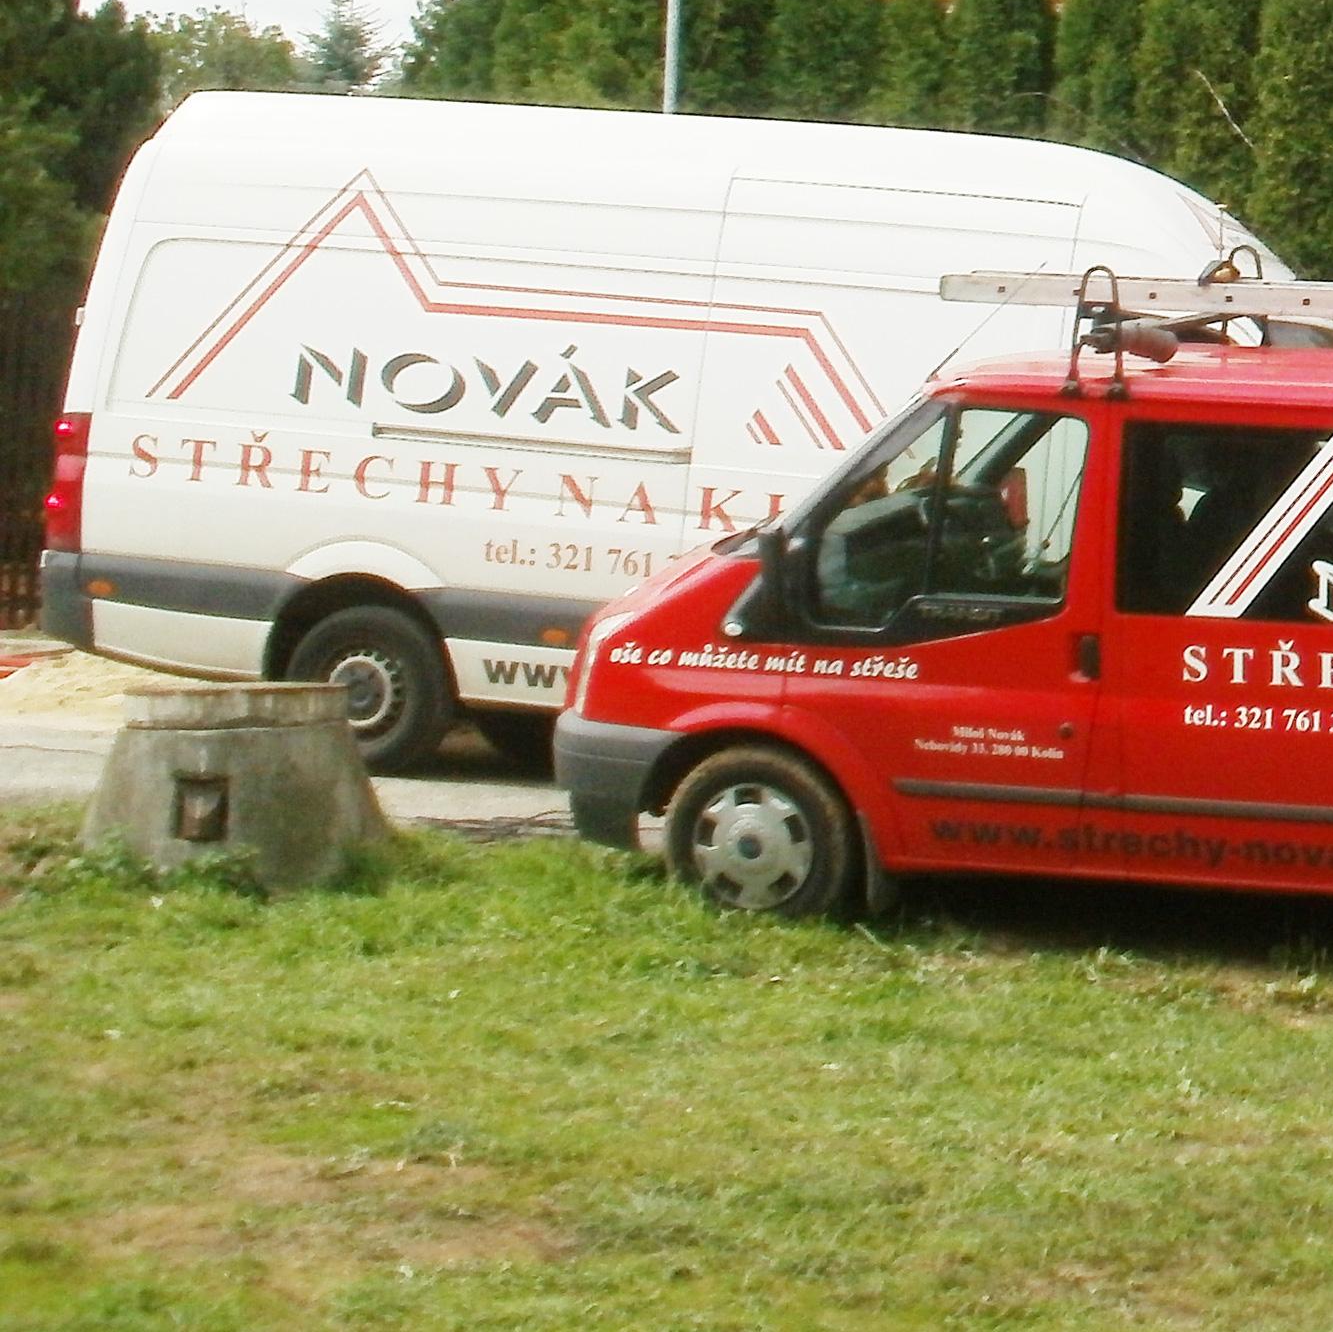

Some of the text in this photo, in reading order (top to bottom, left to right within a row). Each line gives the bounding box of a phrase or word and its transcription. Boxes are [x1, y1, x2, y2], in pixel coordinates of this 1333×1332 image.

[289, 343, 681, 434] NOVÁK
[129, 430, 523, 511] STŘECHY
[555, 473, 657, 526] NA
[484, 538, 652, 578] tel.: 321 761
[483, 658, 569, 689] ww
[646, 649, 671, 666] co
[678, 644, 759, 671] můžete
[764, 651, 806, 674] mít
[813, 659, 843, 676] na
[849, 656, 919, 681] střeše
[1183, 703, 1229, 728] tel.:
[1234, 707, 1275, 731] 321
[1281, 709, 1322, 733] 761
